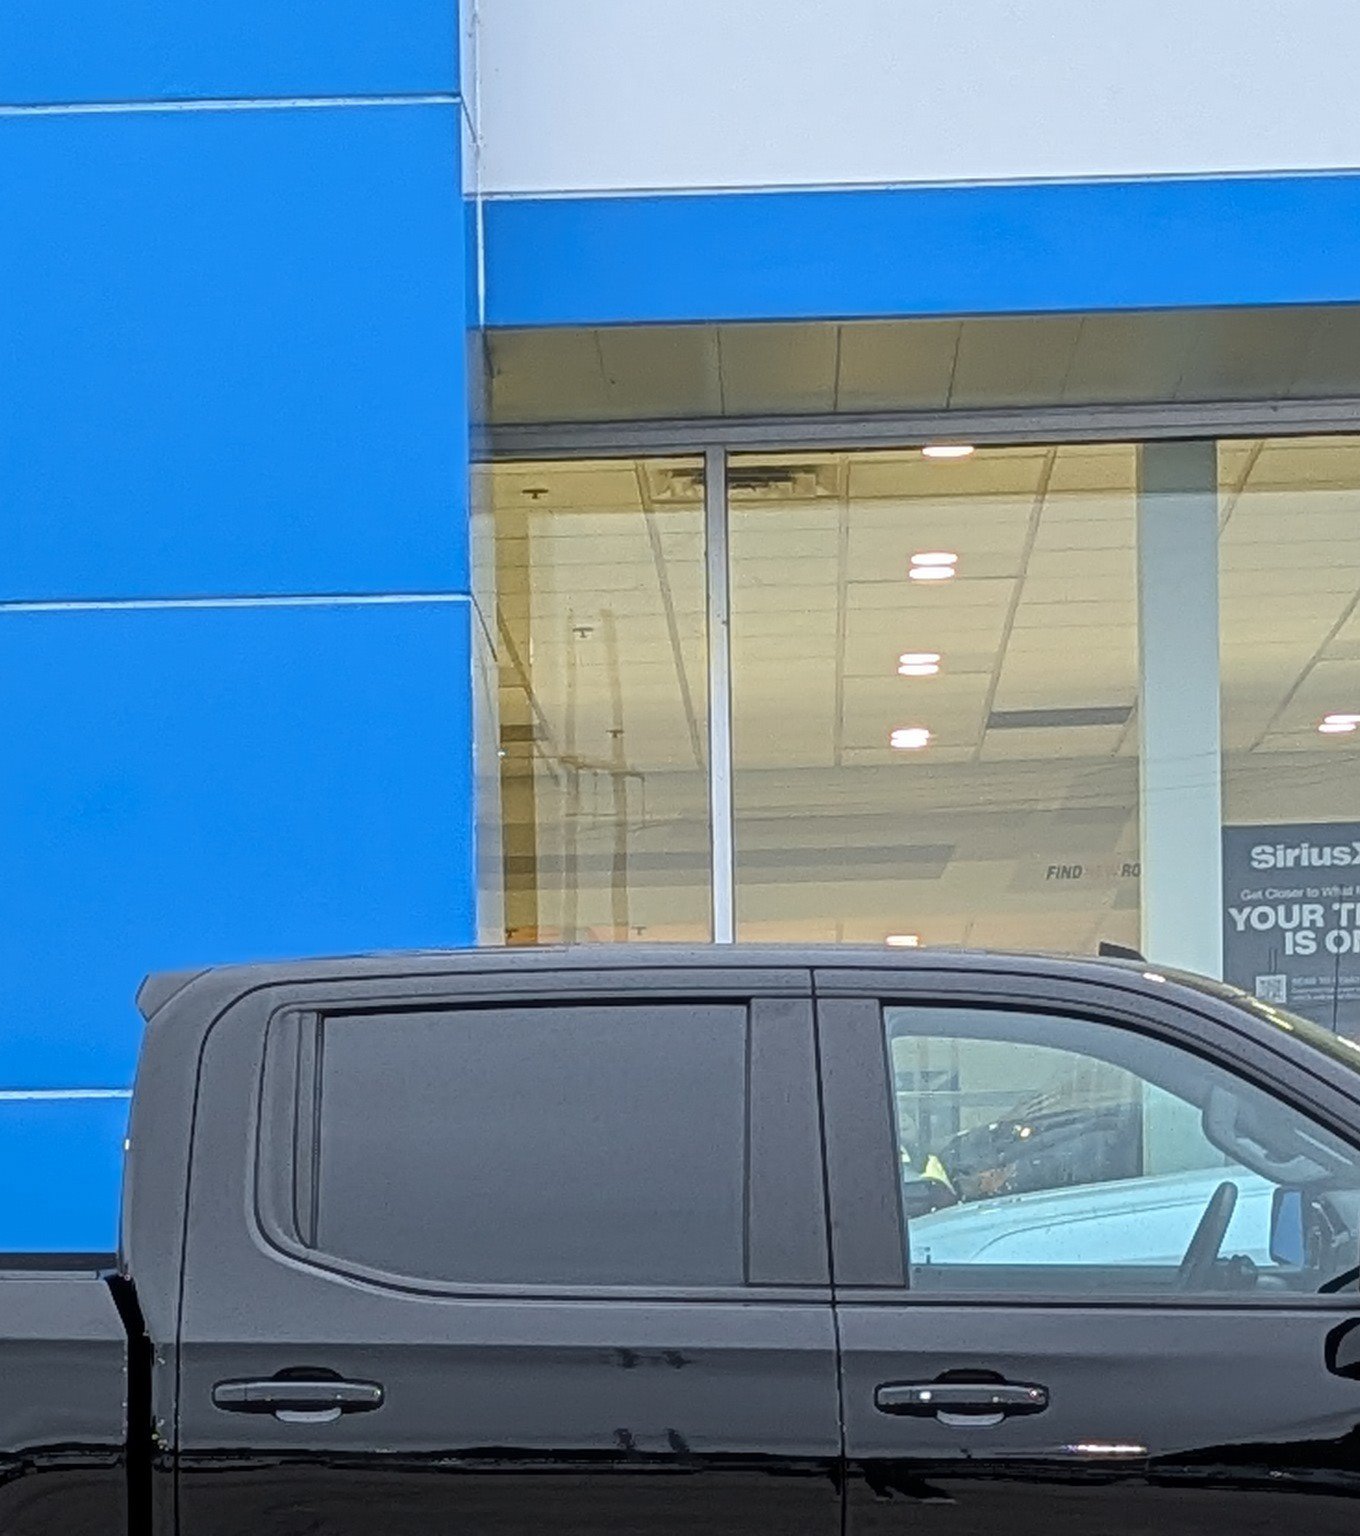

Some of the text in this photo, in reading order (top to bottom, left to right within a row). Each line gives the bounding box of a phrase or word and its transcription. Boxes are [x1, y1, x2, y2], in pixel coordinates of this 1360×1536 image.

[1046, 865, 1083, 880] FIND
[1240, 889, 1262, 901] Get
[1265, 887, 1304, 900] Closer
[1306, 886, 1320, 898] to
[1228, 904, 1325, 931] YOUR
[1285, 930, 1317, 955] IS
